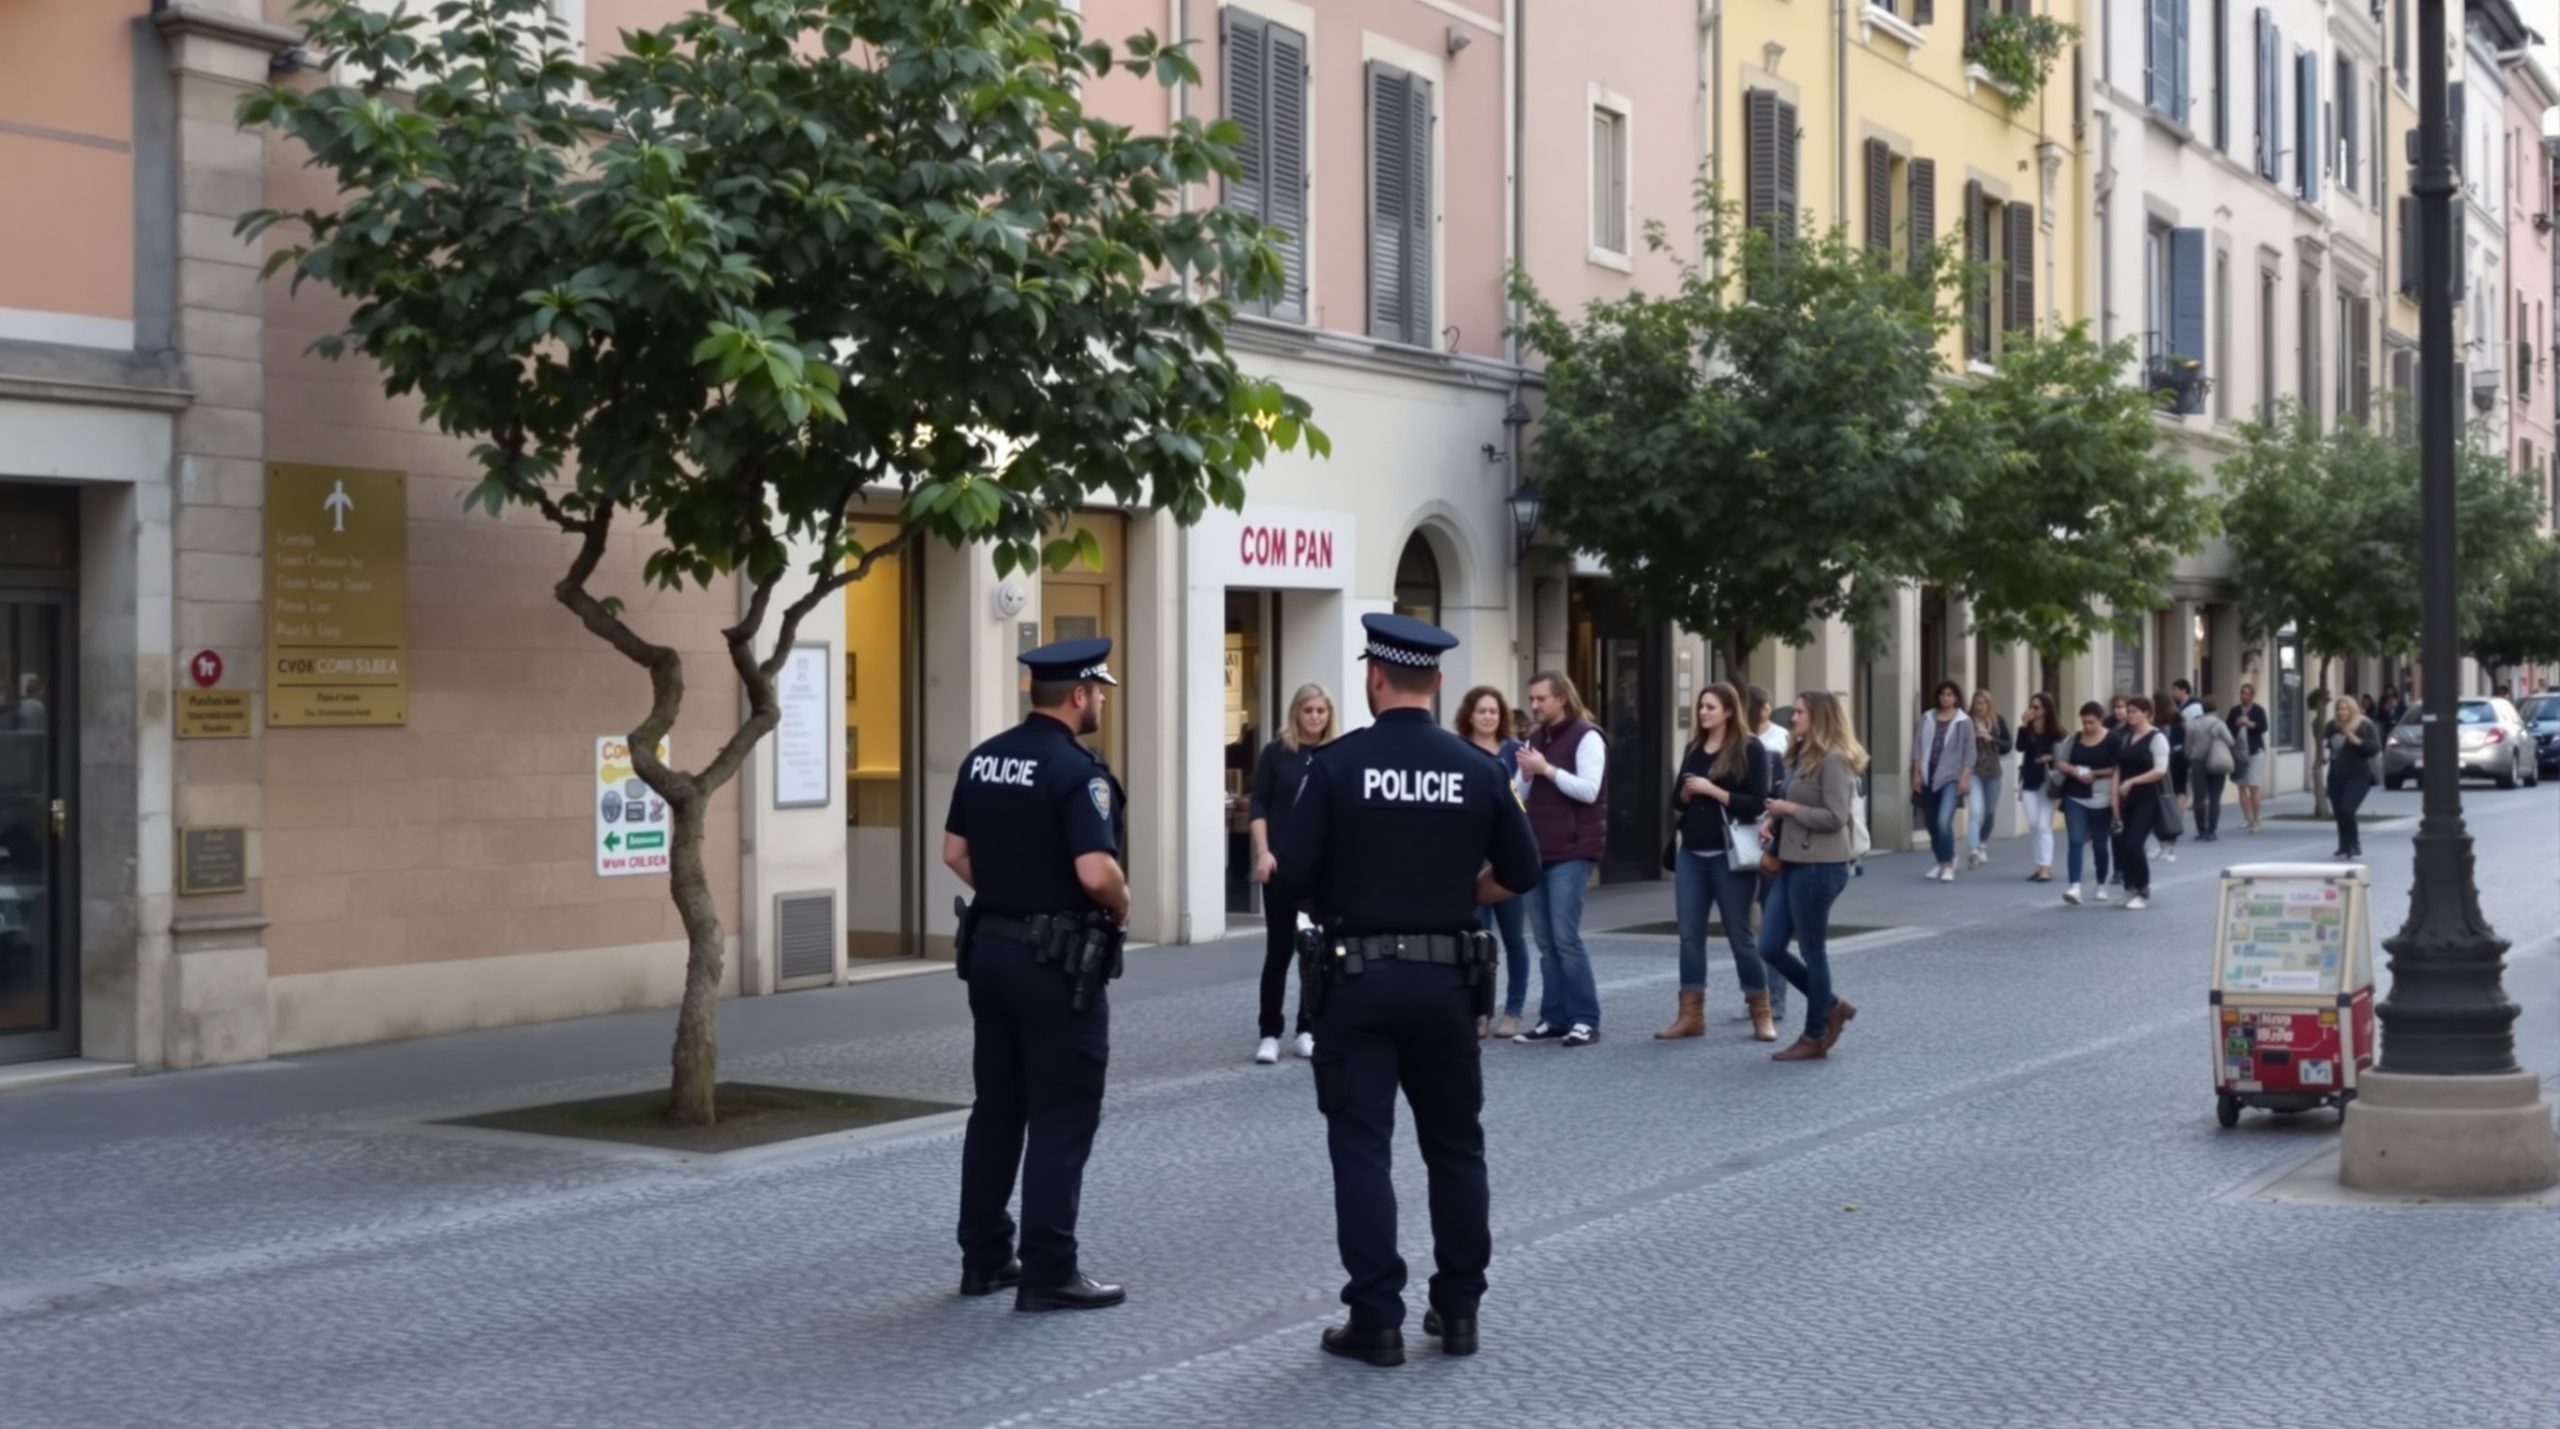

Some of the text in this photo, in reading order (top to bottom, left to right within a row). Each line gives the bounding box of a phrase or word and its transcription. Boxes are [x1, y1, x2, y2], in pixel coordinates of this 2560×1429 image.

[1240, 525, 1332, 568] COM PAN
[970, 755, 1038, 787] POLICIE
[1363, 767, 1464, 804] POLICIE
